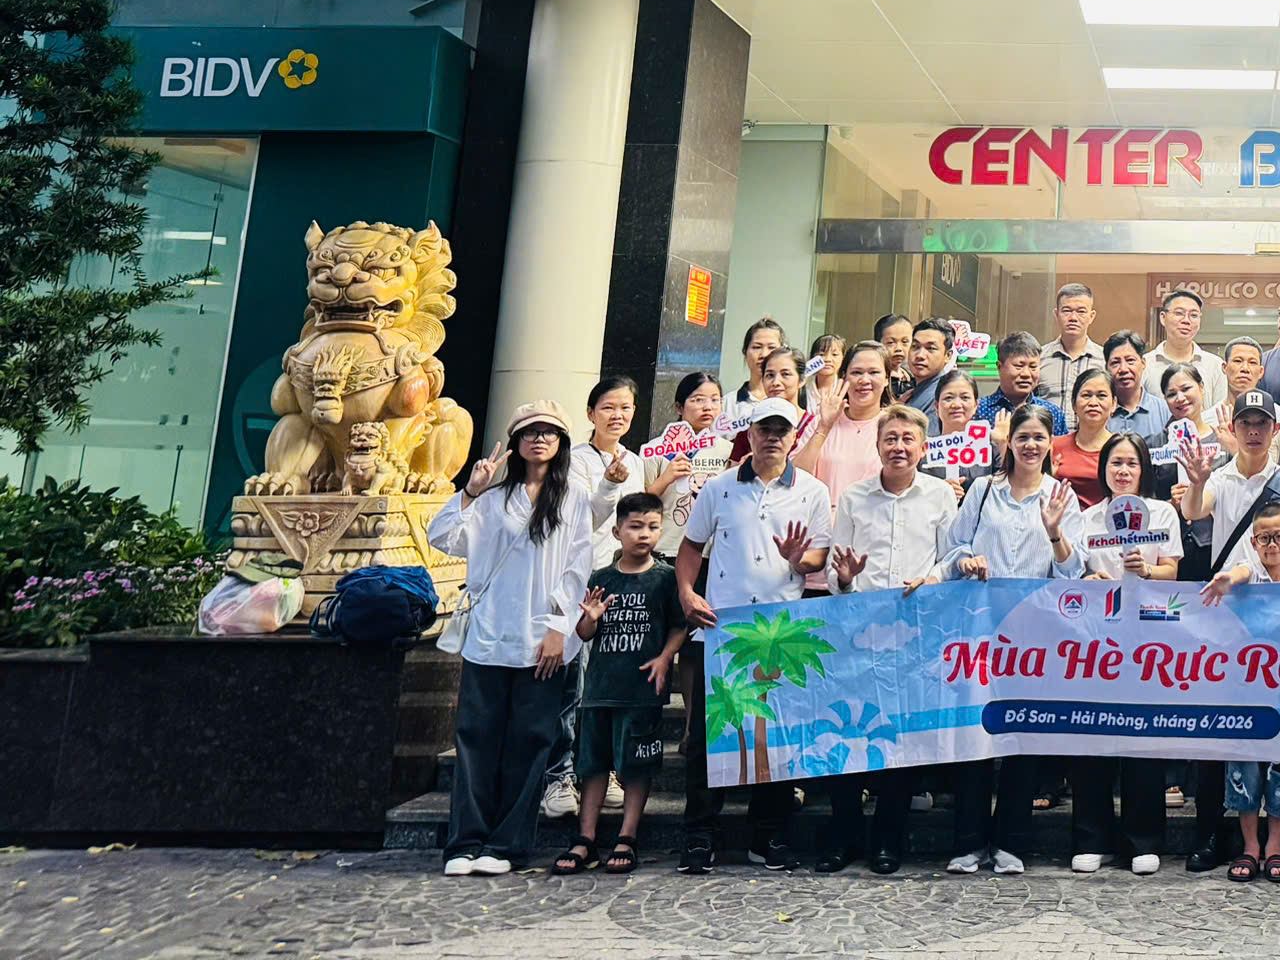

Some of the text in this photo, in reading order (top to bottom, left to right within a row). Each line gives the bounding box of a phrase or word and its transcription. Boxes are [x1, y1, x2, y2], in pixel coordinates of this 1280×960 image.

[160, 57, 280, 97] BIDV
[929, 127, 1203, 186] CENTER
[692, 458, 728, 467] BERRY
[947, 441, 975, 465] SỐ
[979, 448, 988, 464] 1
[621, 593, 646, 607] YOU
[600, 633, 645, 652] KNOW
[943, 634, 1047, 686] Mùa
[1057, 637, 1124, 680] Hè
[1132, 642, 1229, 691] Rực
[1028, 709, 1056, 723] Sơn
[1071, 710, 1096, 725] Hải
[1098, 712, 1148, 730] Phòng,
[1153, 714, 1197, 731] tháng
[1200, 714, 1253, 730] 6/2026
